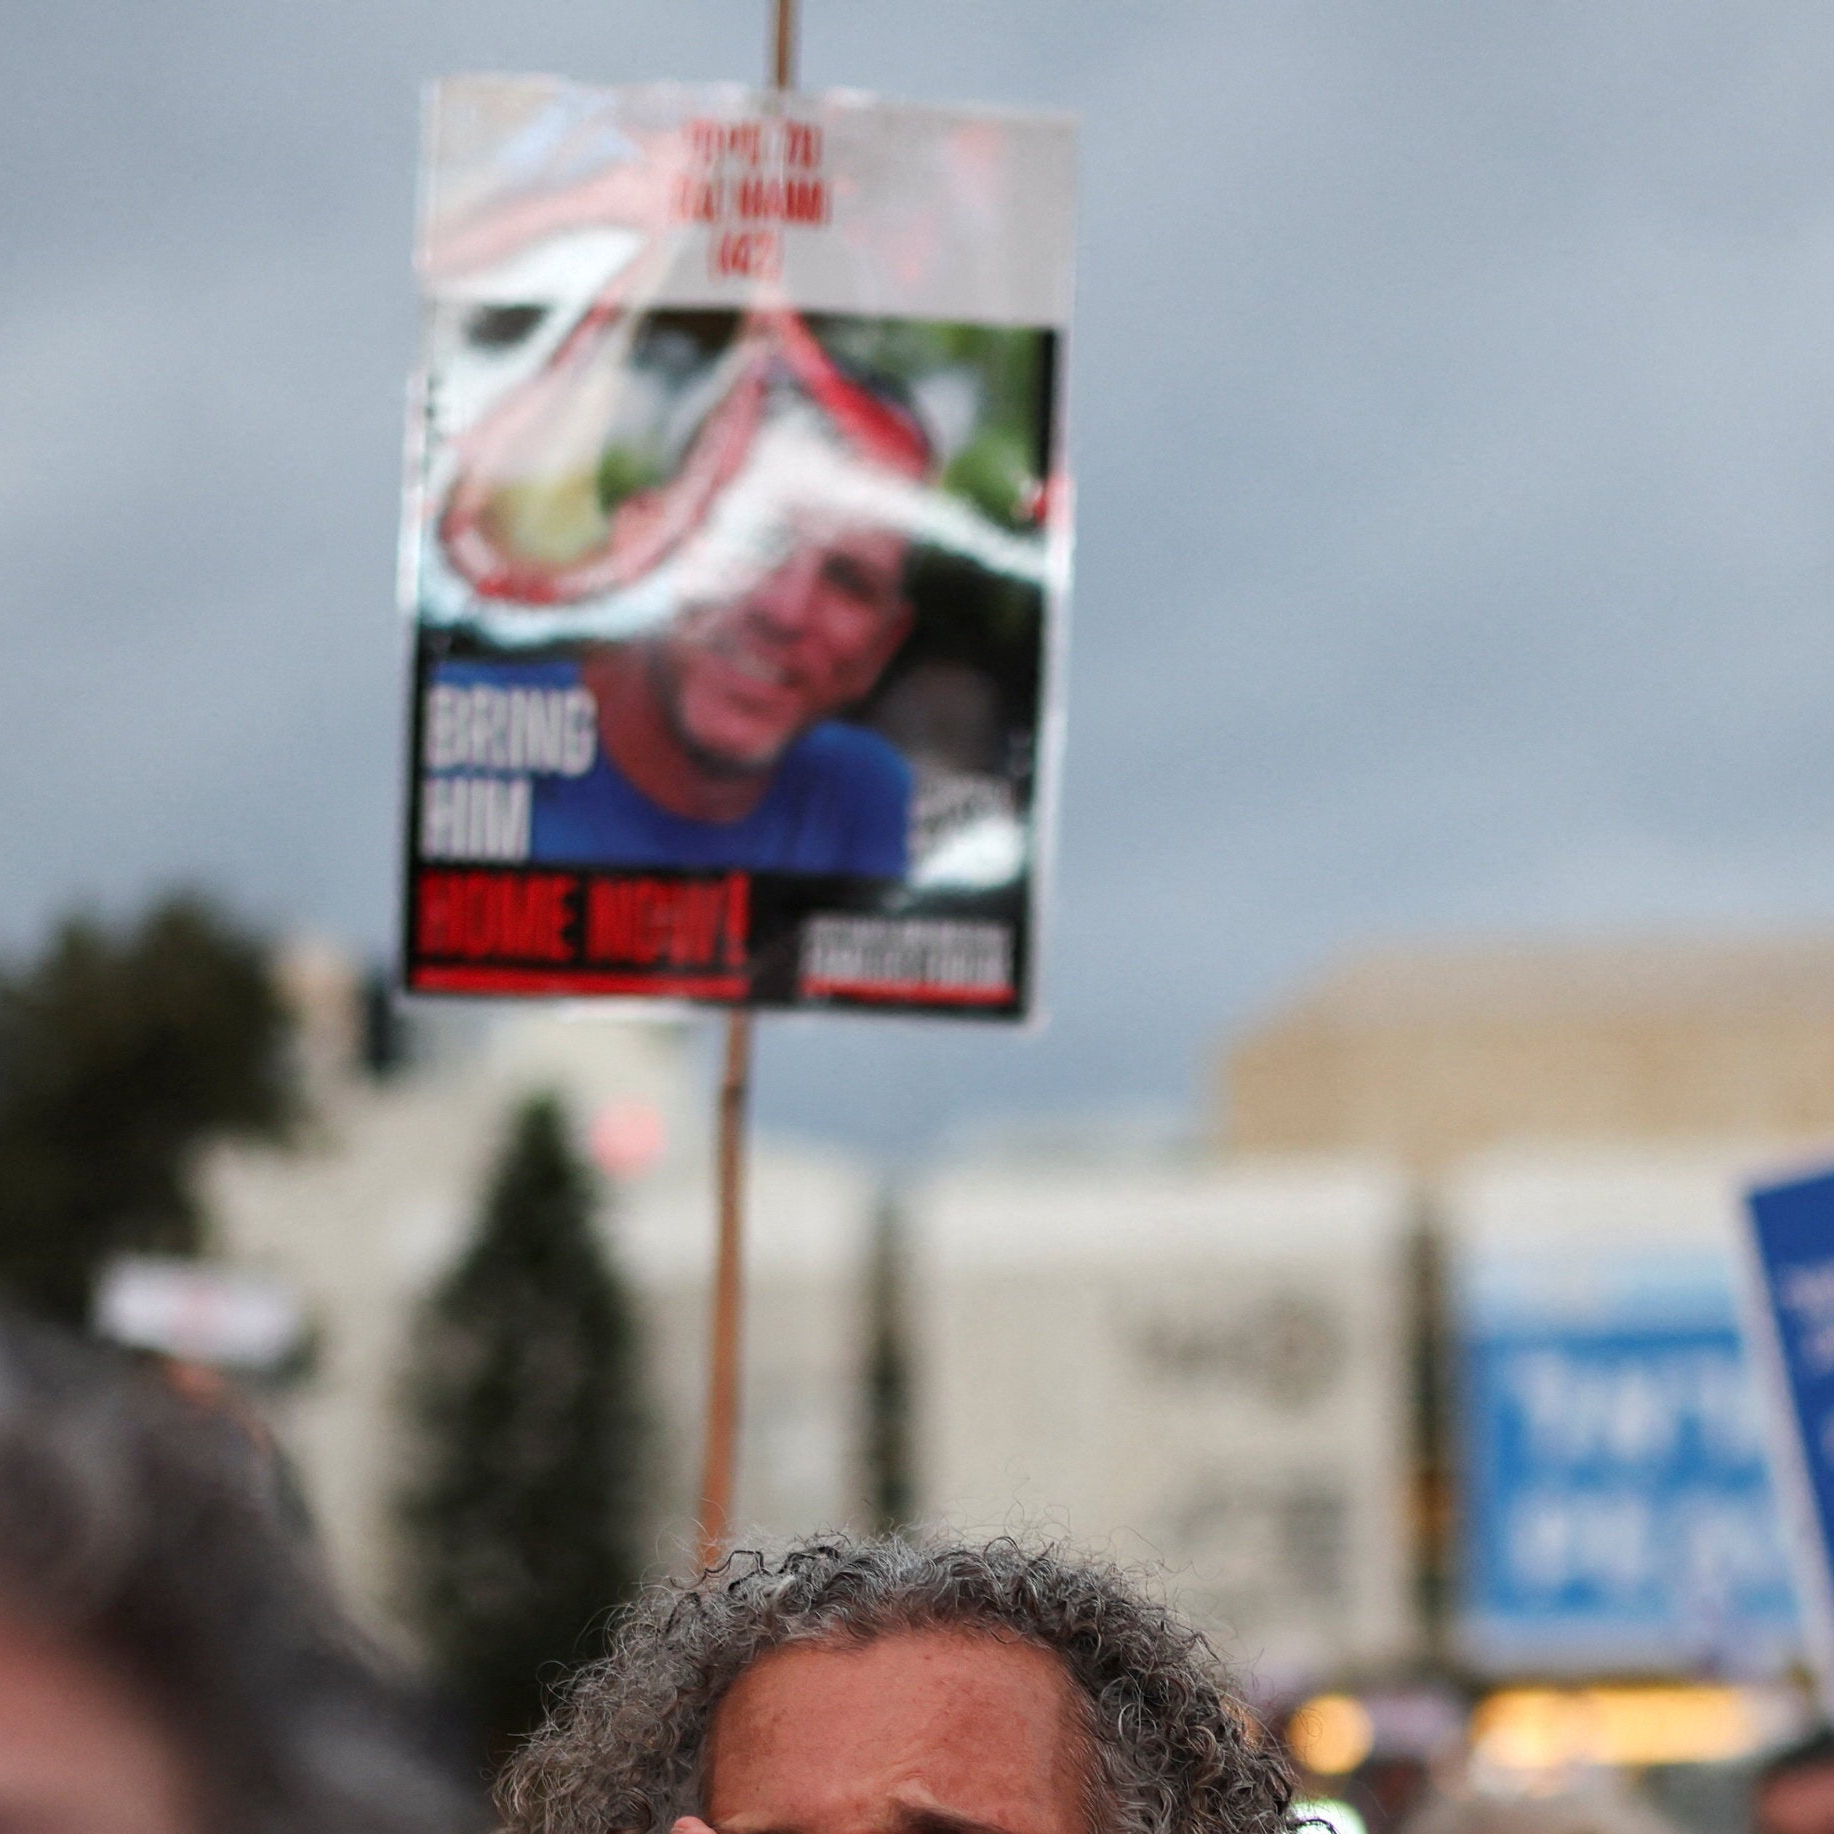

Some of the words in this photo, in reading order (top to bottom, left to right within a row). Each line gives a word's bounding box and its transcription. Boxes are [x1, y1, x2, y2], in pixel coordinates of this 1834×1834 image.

[424, 684, 597, 777] BRING
[421, 777, 532, 863] HIM
[419, 871, 577, 961] HOME
[587, 869, 750, 966] NOW!
